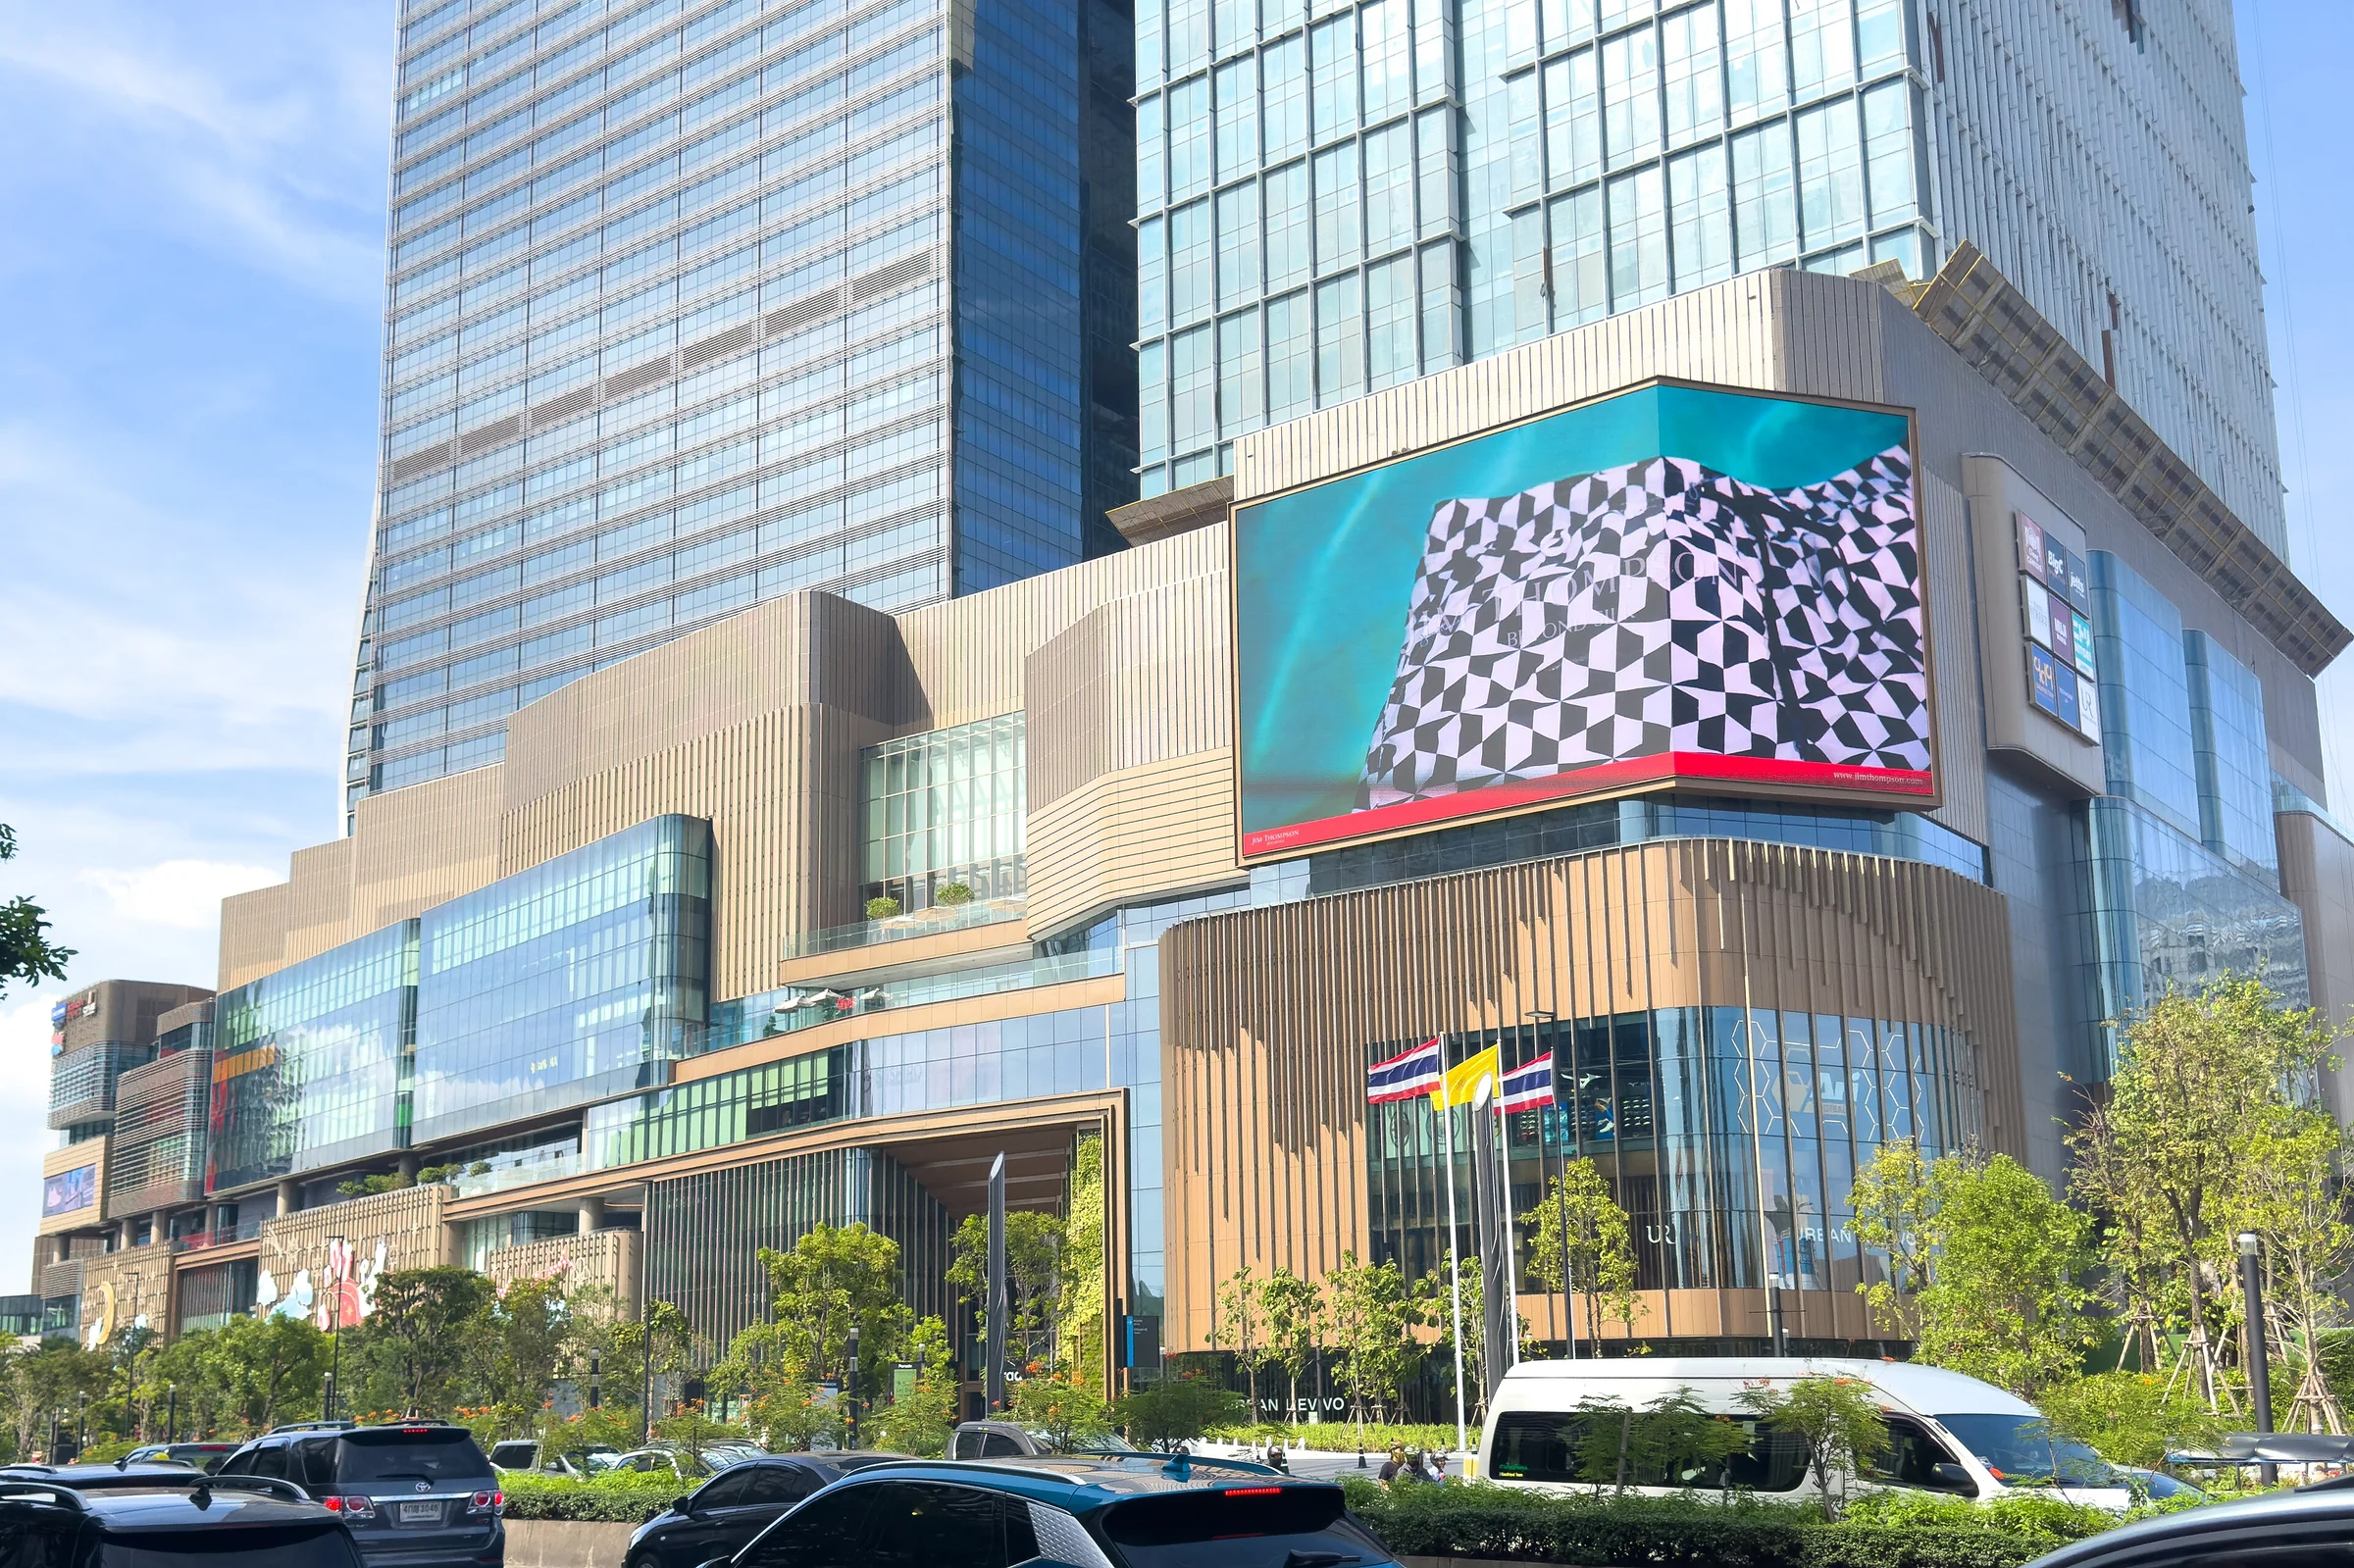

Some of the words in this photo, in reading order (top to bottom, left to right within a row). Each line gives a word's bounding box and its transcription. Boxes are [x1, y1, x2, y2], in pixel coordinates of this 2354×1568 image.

[1482, 550, 1743, 623] THOMPSON
[2071, 572, 2085, 593] jetts
[1832, 771, 1923, 785] www.jimthompson.com
[1251, 836, 1263, 846] JIM
[1264, 830, 1300, 842] THOMPSON
[1645, 1225, 1675, 1244] UR
[1286, 1396, 1345, 1412] EVVO
